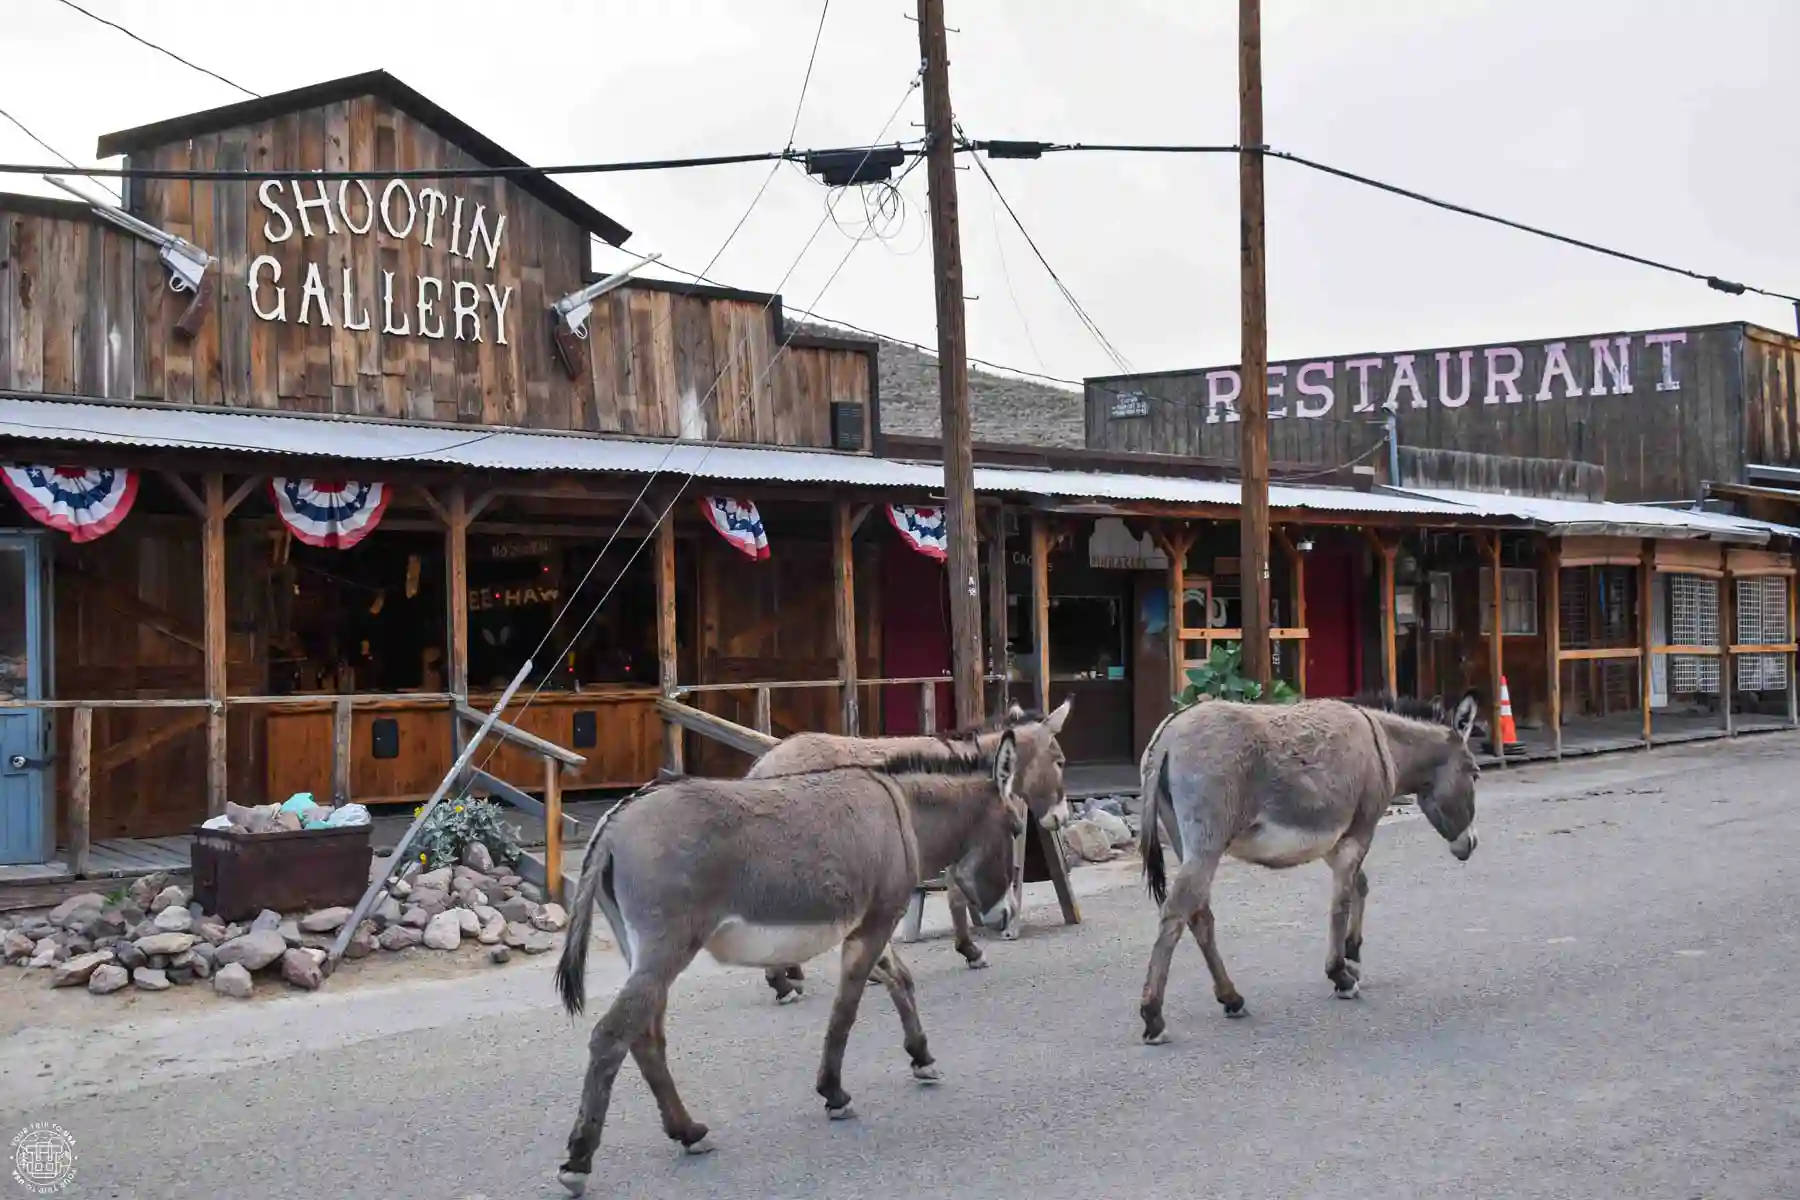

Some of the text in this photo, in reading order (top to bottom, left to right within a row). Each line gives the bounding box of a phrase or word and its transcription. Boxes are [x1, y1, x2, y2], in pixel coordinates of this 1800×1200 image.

[258, 169, 506, 270] SHOOTIN
[247, 254, 513, 345] GALLERY
[1205, 332, 1688, 424] RESTAURANT
